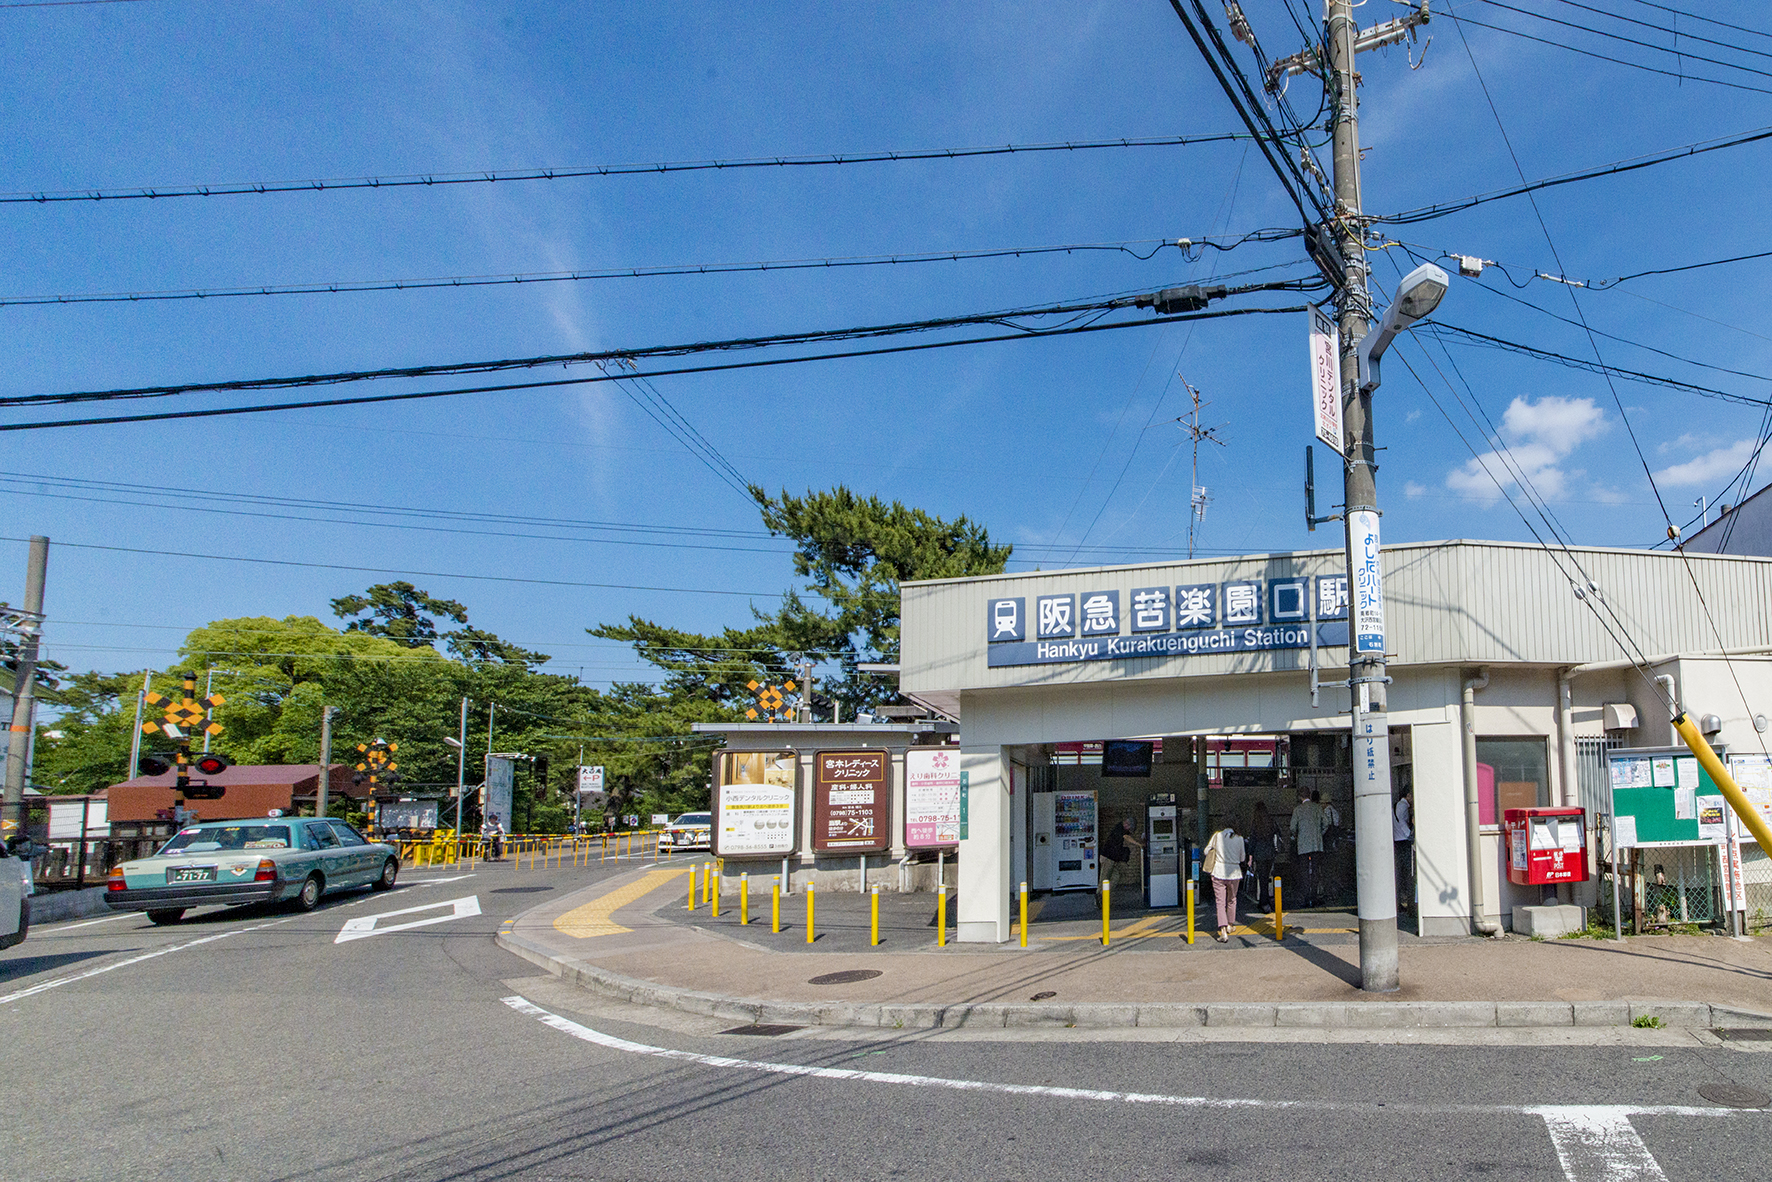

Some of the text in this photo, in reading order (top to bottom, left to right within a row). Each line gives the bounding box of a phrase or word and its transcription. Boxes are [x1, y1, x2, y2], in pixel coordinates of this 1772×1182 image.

[1319, 355, 1327, 410] クリニック
[1358, 568, 1367, 609] クリニック
[1039, 577, 1348, 635] 阪急苦楽園口駅
[1037, 628, 1307, 659] Hankyu Kurakuenguchi Station
[1366, 724, 1376, 780] はり紙禁止
[834, 769, 870, 778] クリニック
[910, 772, 960, 780] えり歯科クリニ
[726, 794, 790, 802] 小西デンタルクリニック
[919, 815, 960, 823] 0798-75-1
[183, 872, 209, 881] 71-77
